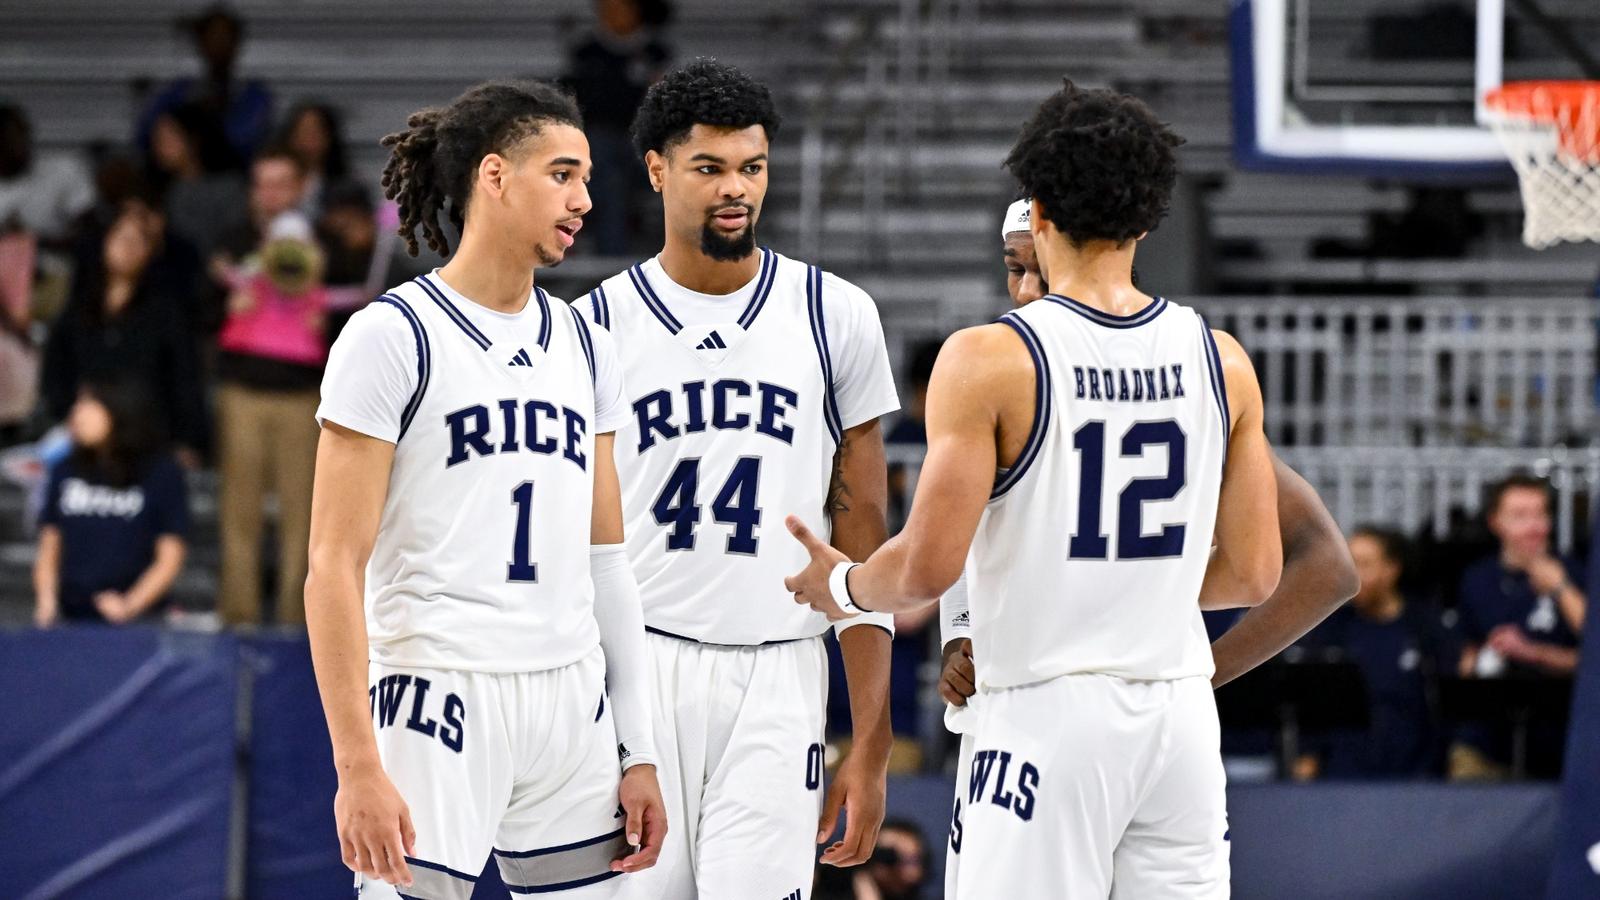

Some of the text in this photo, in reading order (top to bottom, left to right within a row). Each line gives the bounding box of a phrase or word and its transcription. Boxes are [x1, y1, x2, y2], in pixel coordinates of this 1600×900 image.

[632, 378, 799, 455] RICE
[1072, 364, 1185, 401] BROADNAX
[445, 398, 587, 473] RICE
[505, 479, 539, 584] 1
[650, 455, 763, 557] 44
[1067, 417, 1188, 561] 12
